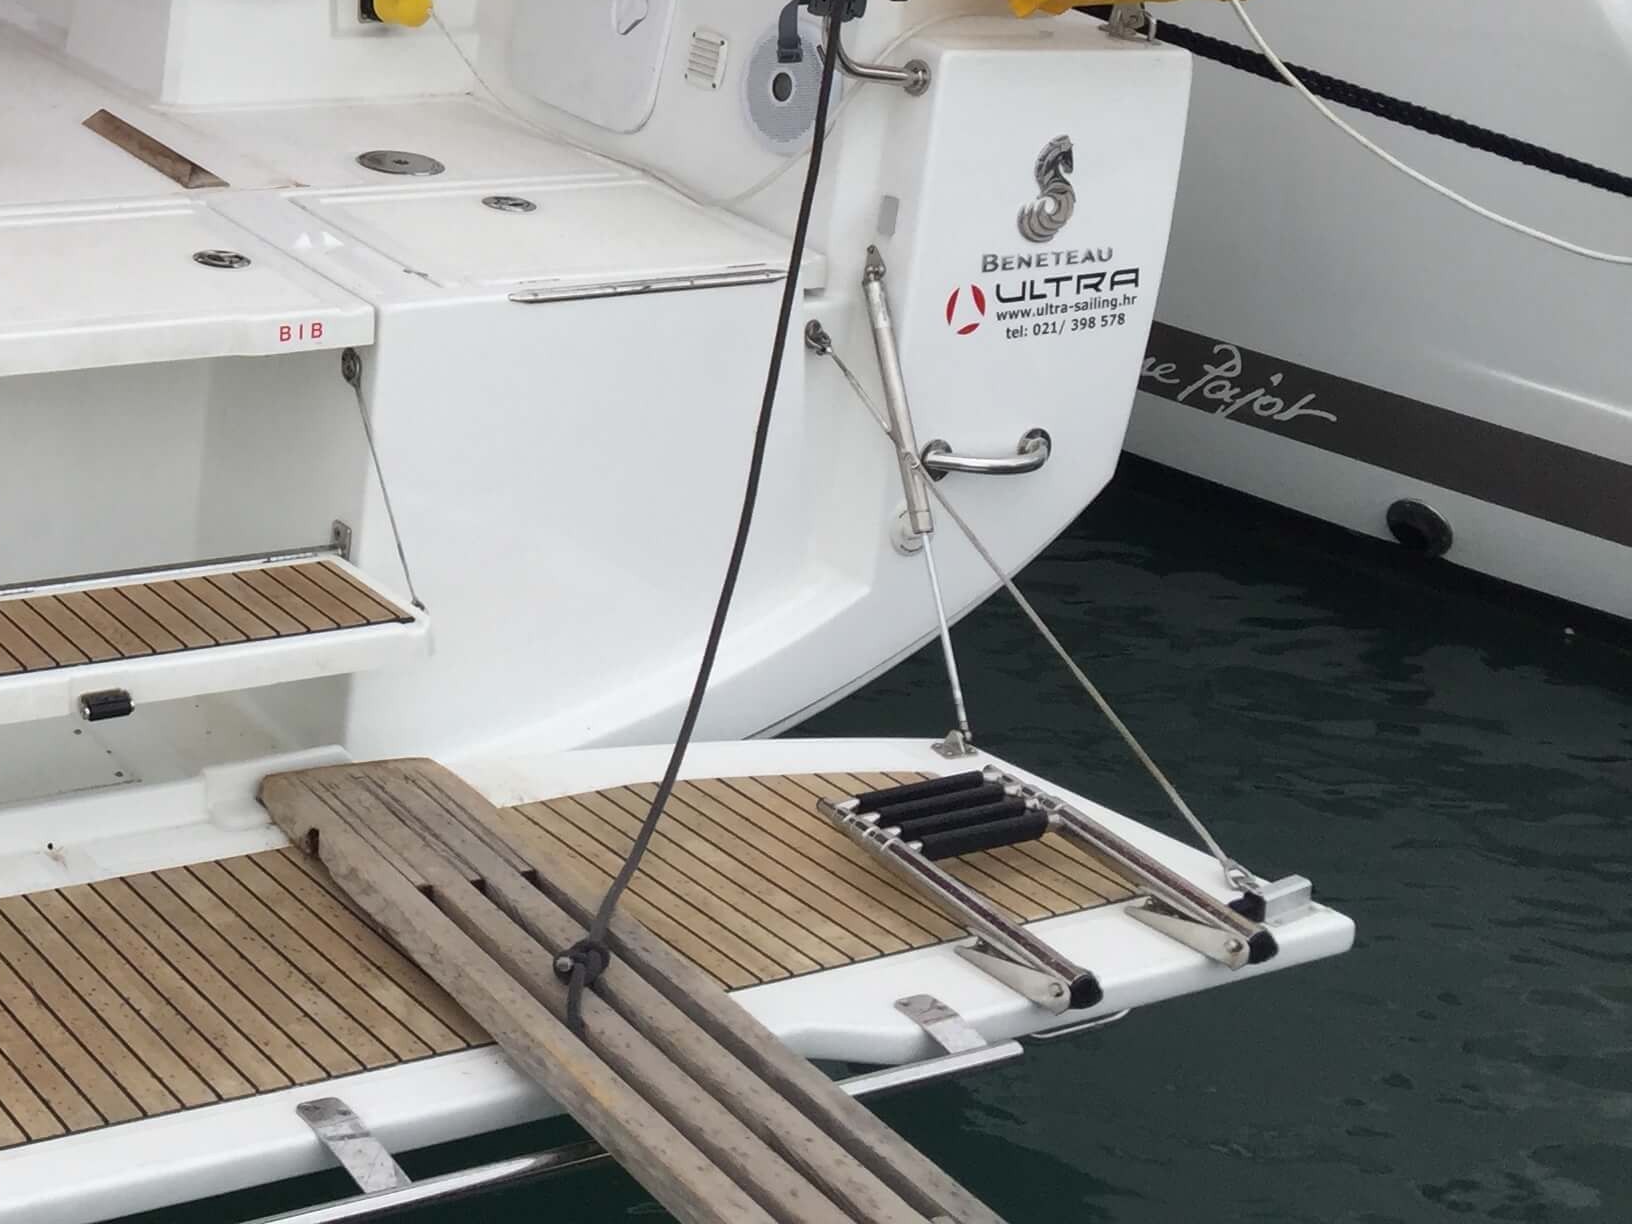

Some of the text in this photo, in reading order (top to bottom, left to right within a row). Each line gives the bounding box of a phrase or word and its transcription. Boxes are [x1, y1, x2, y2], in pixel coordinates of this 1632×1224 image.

[995, 267, 1139, 303] ULTRA
[996, 294, 1138, 321] www.ultra-sailing.hr
[1005, 313, 1126, 339] tel: 021/ 398 578
